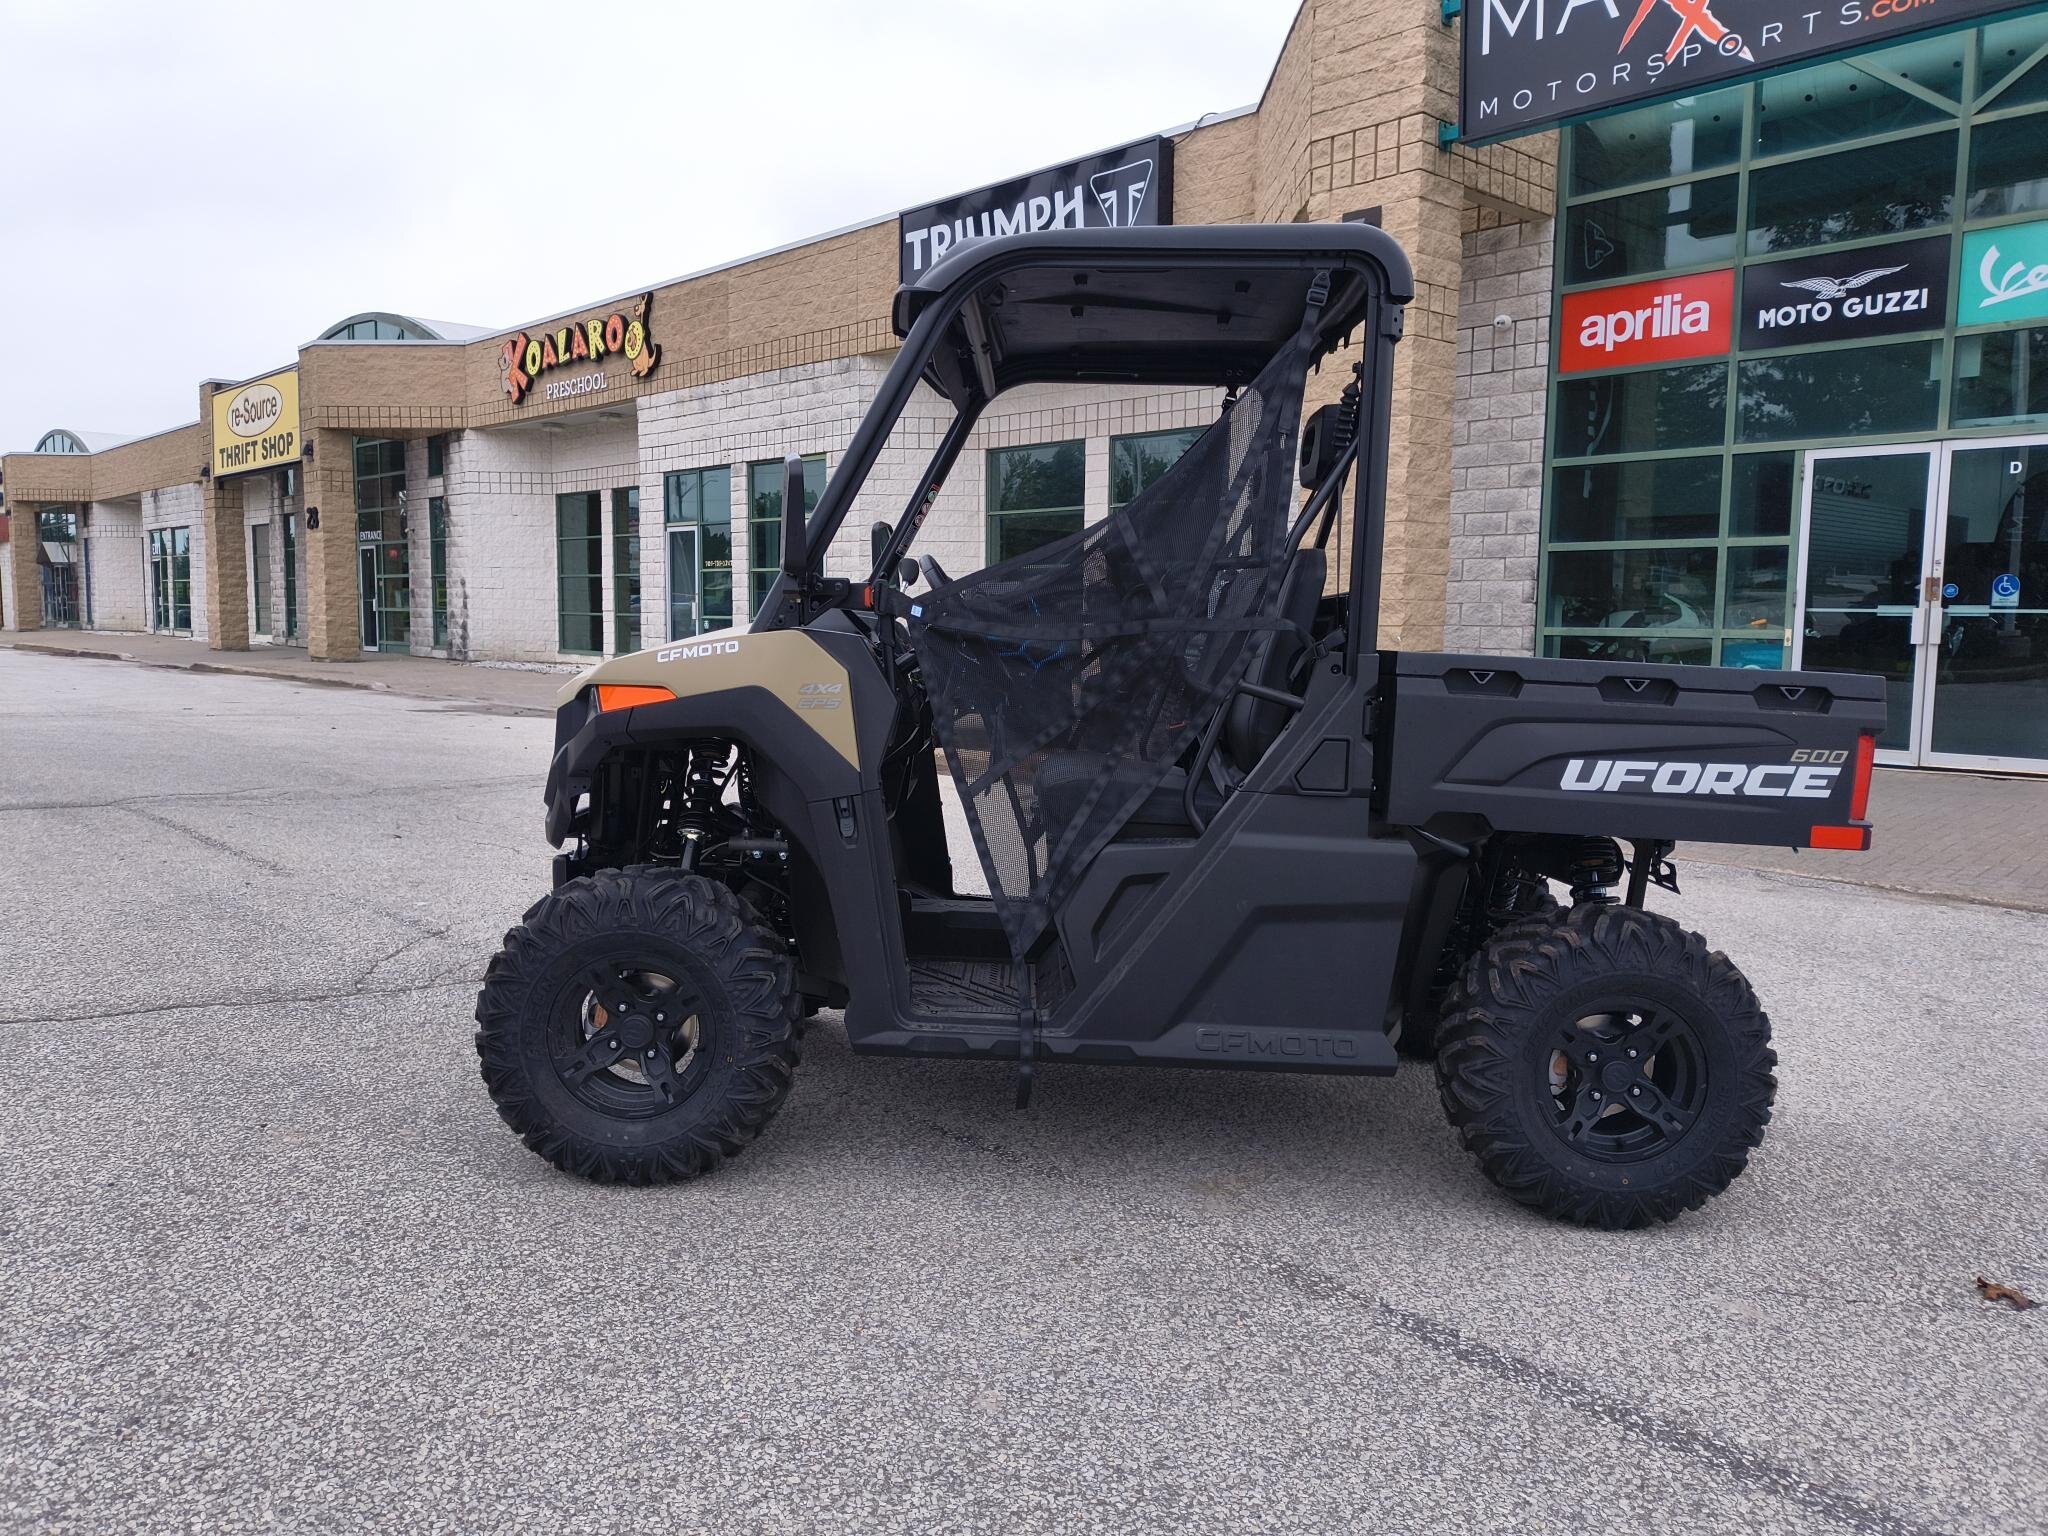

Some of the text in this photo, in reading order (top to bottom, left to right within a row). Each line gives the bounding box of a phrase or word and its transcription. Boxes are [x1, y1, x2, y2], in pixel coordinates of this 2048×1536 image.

[1579, 293, 1710, 352] aprilia
[1759, 287, 1929, 329] MOTO GUZZI
[502, 313, 646, 405] KOALAROO
[546, 372, 608, 400] PRESCHOOL
[231, 396, 278, 428] re-Source
[219, 431, 294, 469] THRIFT SHOP
[2009, 461, 2023, 474] D
[360, 530, 383, 540] ENTRANCE
[656, 640, 740, 663] CFMOTO
[799, 682, 843, 695] 4X4
[1790, 748, 1849, 764] 600
[1559, 759, 1842, 798] UFORCE
[1195, 1028, 1360, 1059] CFMOTO
